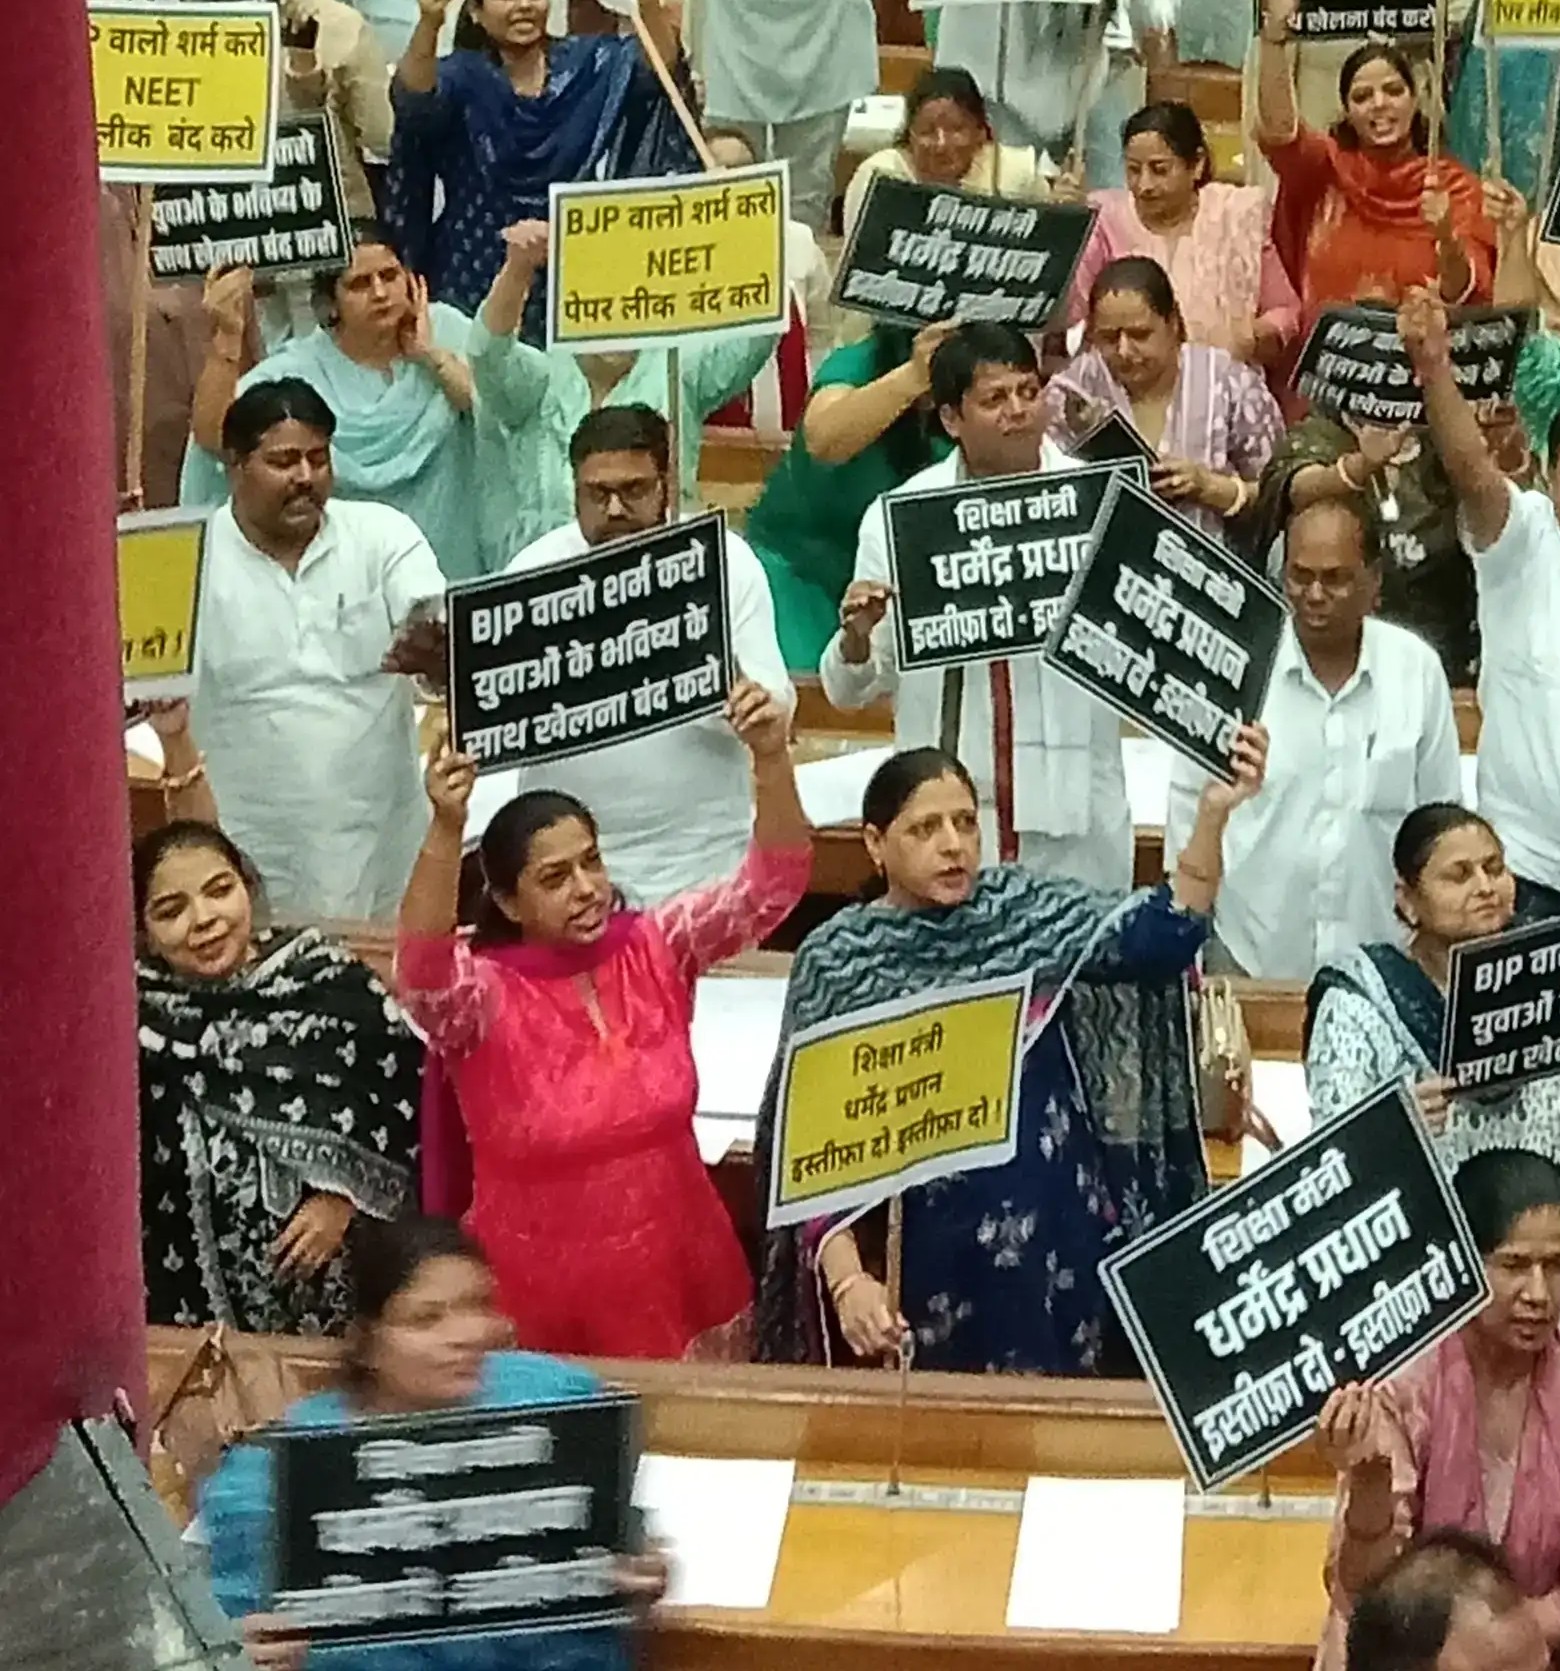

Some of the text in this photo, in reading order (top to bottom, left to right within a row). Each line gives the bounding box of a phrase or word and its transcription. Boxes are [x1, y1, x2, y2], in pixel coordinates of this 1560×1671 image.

[109, 20, 170, 57] वालो
[177, 22, 218, 57] शर्म
[223, 22, 266, 57] करो
[124, 76, 202, 106] NEET
[167, 118, 204, 151] बंद
[211, 115, 255, 153] करो
[566, 181, 776, 236] BJP वालो शर्म करो
[646, 243, 717, 278] NEET
[565, 291, 614, 324] पेपर
[620, 286, 677, 320] लीक
[728, 273, 770, 310] करो
[953, 498, 1022, 533] शिक्षा
[471, 538, 706, 646] BJP वालो शर्म करो
[989, 595, 1014, 639] दो
[565, 640, 596, 678] के
[600, 618, 680, 668] भविष्य
[684, 602, 710, 640] के
[462, 654, 722, 760] साथ खेलना बंद करो
[1474, 952, 1524, 994] BJP
[852, 1022, 944, 1076] शिक्षा मंत्री
[871, 1125, 891, 1159] दो
[967, 1094, 988, 1129] दो
[1200, 1147, 1354, 1274] शिक्षा मंत्री
[1298, 1187, 1412, 1301] प्रधान
[1295, 1331, 1337, 1394] दो
[1420, 1243, 1456, 1301] दो
